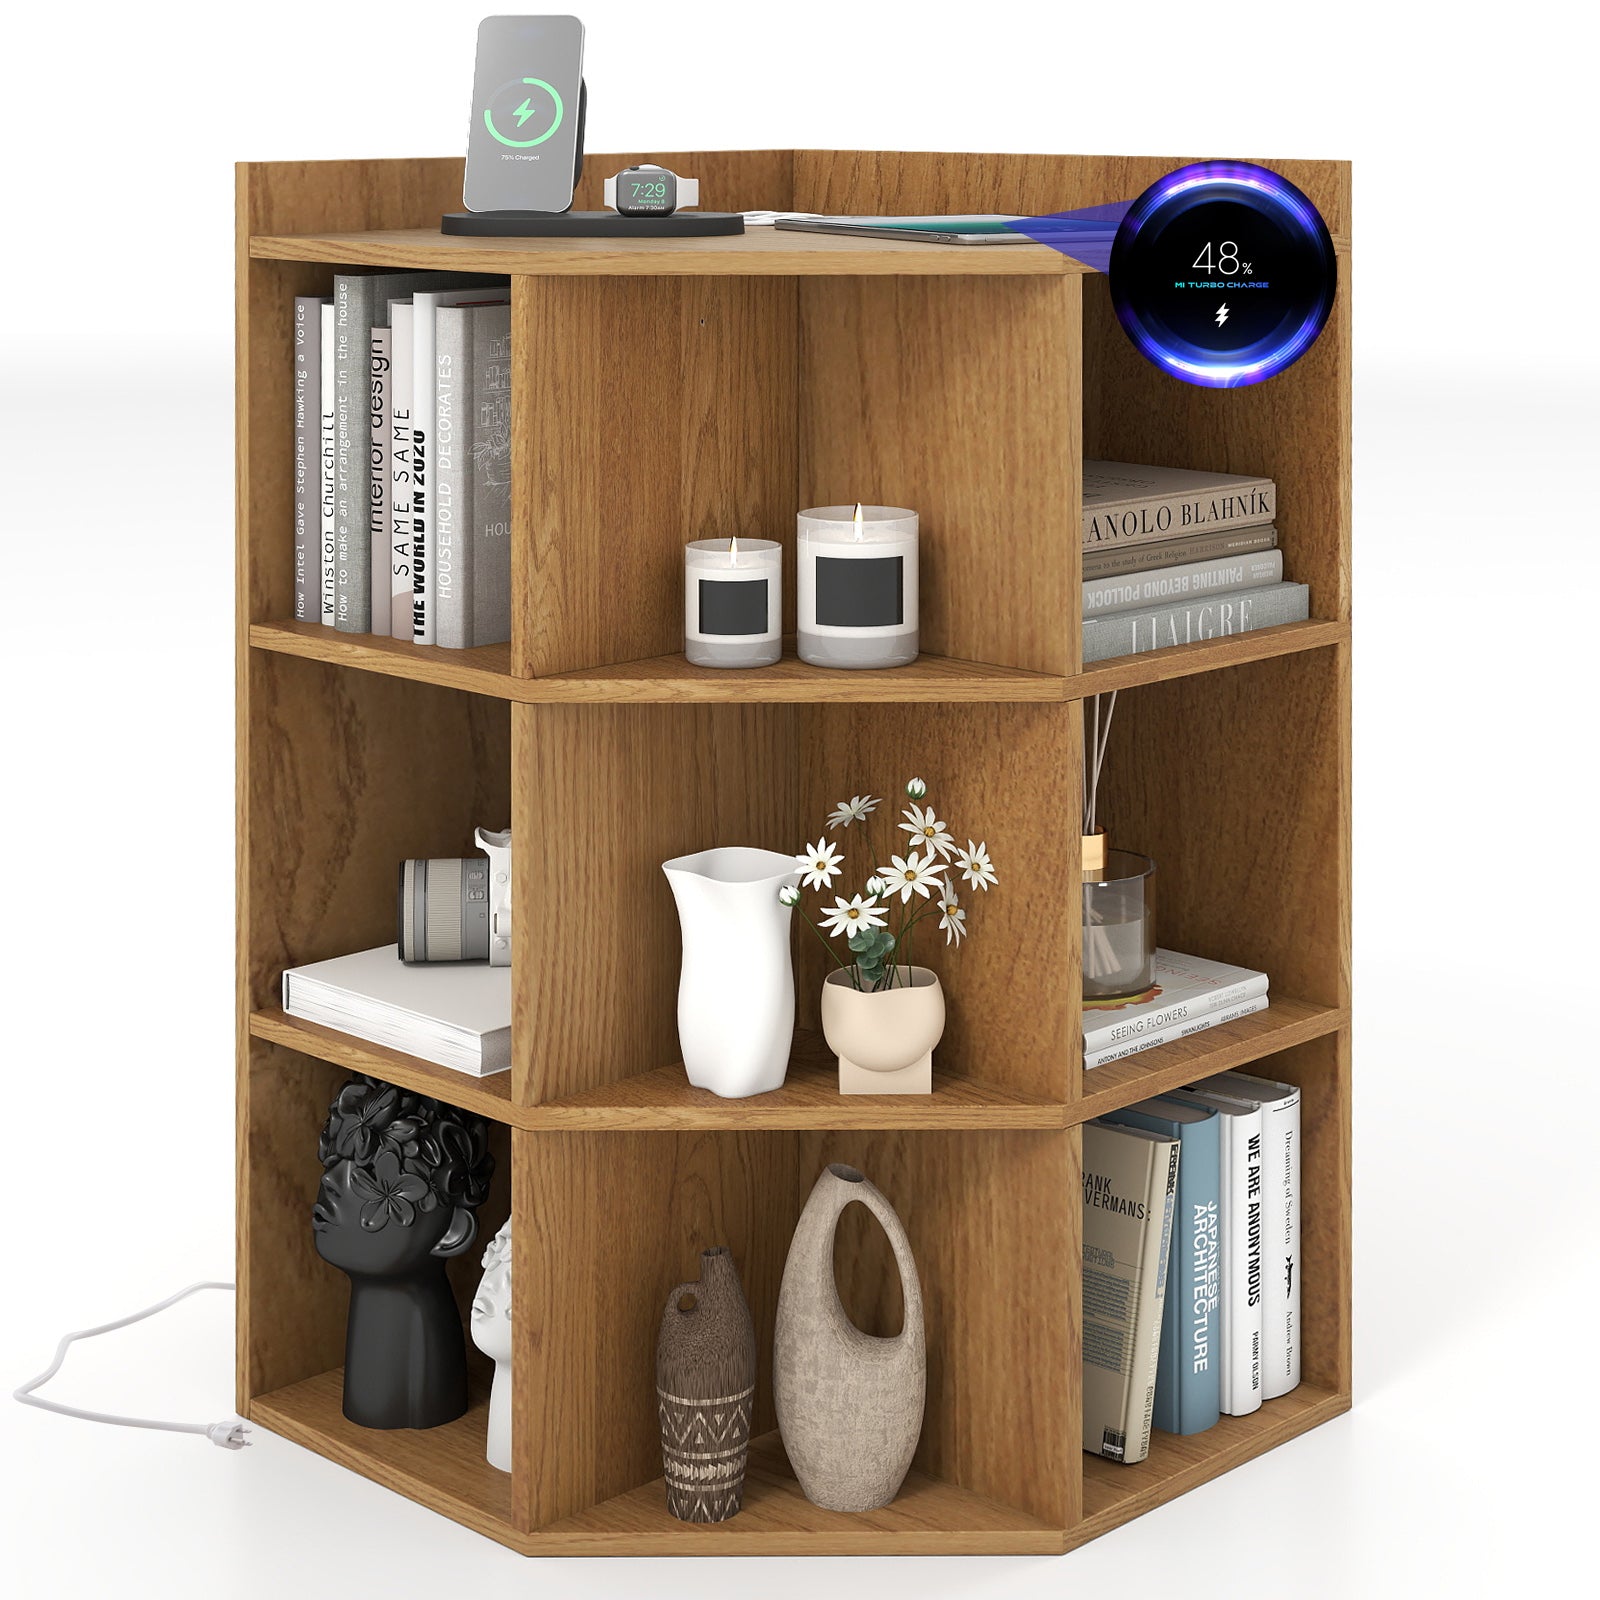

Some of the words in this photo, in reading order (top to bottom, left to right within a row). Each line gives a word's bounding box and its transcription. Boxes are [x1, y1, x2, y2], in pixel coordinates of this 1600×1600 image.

[631, 183, 666, 198] 7:29
[1192, 241, 1252, 275] 48%
[1174, 281, 1185, 289] MI
[1188, 281, 1225, 289] TURBO
[1226, 281, 1269, 289] CHARGE
[337, 283, 348, 327] house
[296, 304, 305, 345] Voice
[297, 354, 305, 362] a
[337, 335, 348, 361] the
[337, 370, 348, 386] in
[371, 339, 390, 429] design
[296, 370, 308, 428] Hawking
[438, 354, 452, 470] DECORATES
[337, 396, 351, 491] arrangement
[393, 408, 410, 483] SAME
[296, 436, 307, 494] Stephen
[322, 411, 335, 518] Churchill
[371, 438, 384, 533] Interior
[413, 491, 425, 514] IN
[296, 502, 305, 535] Gave
[339, 500, 348, 517] an
[1082, 505, 1172, 544] ANOLO
[1181, 487, 1271, 526] BLAHNÍK
[337, 525, 348, 561] make
[393, 500, 410, 577] SAME
[438, 482, 452, 599] HOUSEHOLD
[296, 544, 305, 584] Intel
[322, 531, 335, 614] Winston
[338, 569, 348, 585] to
[1112, 559, 1121, 568] the
[1121, 555, 1137, 568] study
[1146, 553, 1163, 562] Greek
[1193, 566, 1243, 590] PAINTING
[296, 592, 305, 618] How
[1087, 584, 1140, 609] POLLOCK
[1143, 576, 1189, 599] BEYOND
[337, 594, 348, 622] How
[413, 600, 425, 636] THE
[1110, 1020, 1144, 1041] SEEING
[1146, 1005, 1188, 1029] FLOWERS
[1181, 1020, 1210, 1037] SWANLIGHTS
[1097, 1053, 1118, 1065] ANTONY
[1117, 1049, 1129, 1059] AND
[1128, 1045, 1139, 1055] THE
[1138, 1037, 1164, 1052] JOHNSONS
[1248, 1133, 1260, 1163] WE
[1282, 1130, 1293, 1187] Dreaming
[1248, 1165, 1260, 1199] ARE
[1285, 1188, 1293, 1199] of
[1285, 1200, 1293, 1245] Sweden
[1207, 1200, 1218, 1313] JAPANESE
[1248, 1202, 1260, 1307] ANONYMOUS
[1193, 1204, 1209, 1374] ARCHITECTURE
